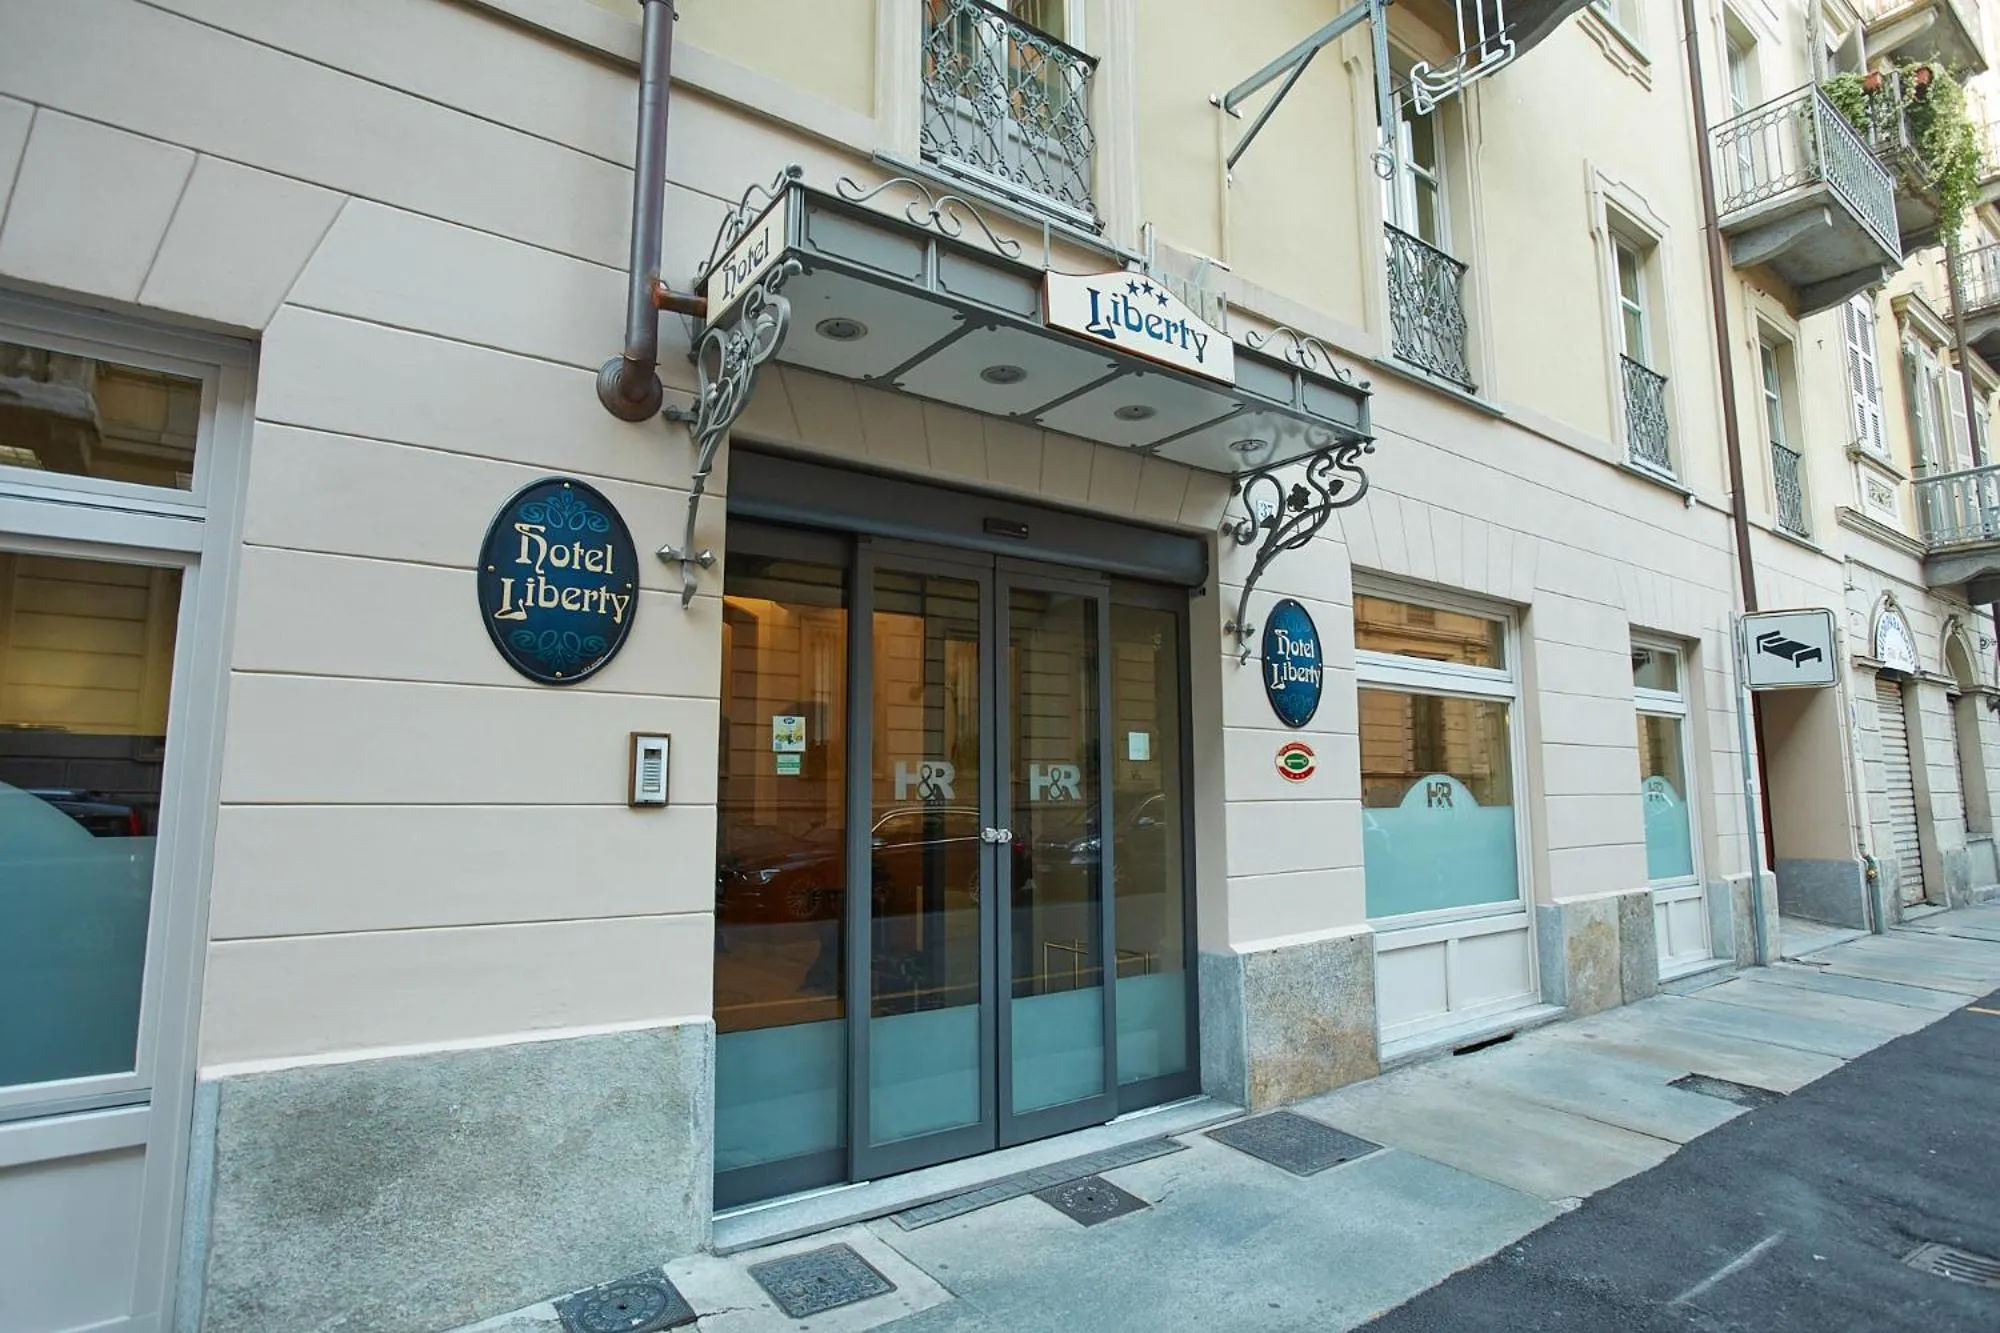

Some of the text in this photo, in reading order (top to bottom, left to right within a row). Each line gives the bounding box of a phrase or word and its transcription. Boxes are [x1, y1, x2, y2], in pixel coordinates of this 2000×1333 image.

[723, 226, 769, 301] Hotel
[1086, 287, 1207, 363] Liberty
[514, 522, 614, 574] Hotel
[494, 574, 630, 624] Liberty
[1274, 628, 1316, 660] Hotel
[1271, 661, 1322, 690] Liberty
[895, 760, 956, 800] H&R
[1029, 763, 1081, 800] H&R
